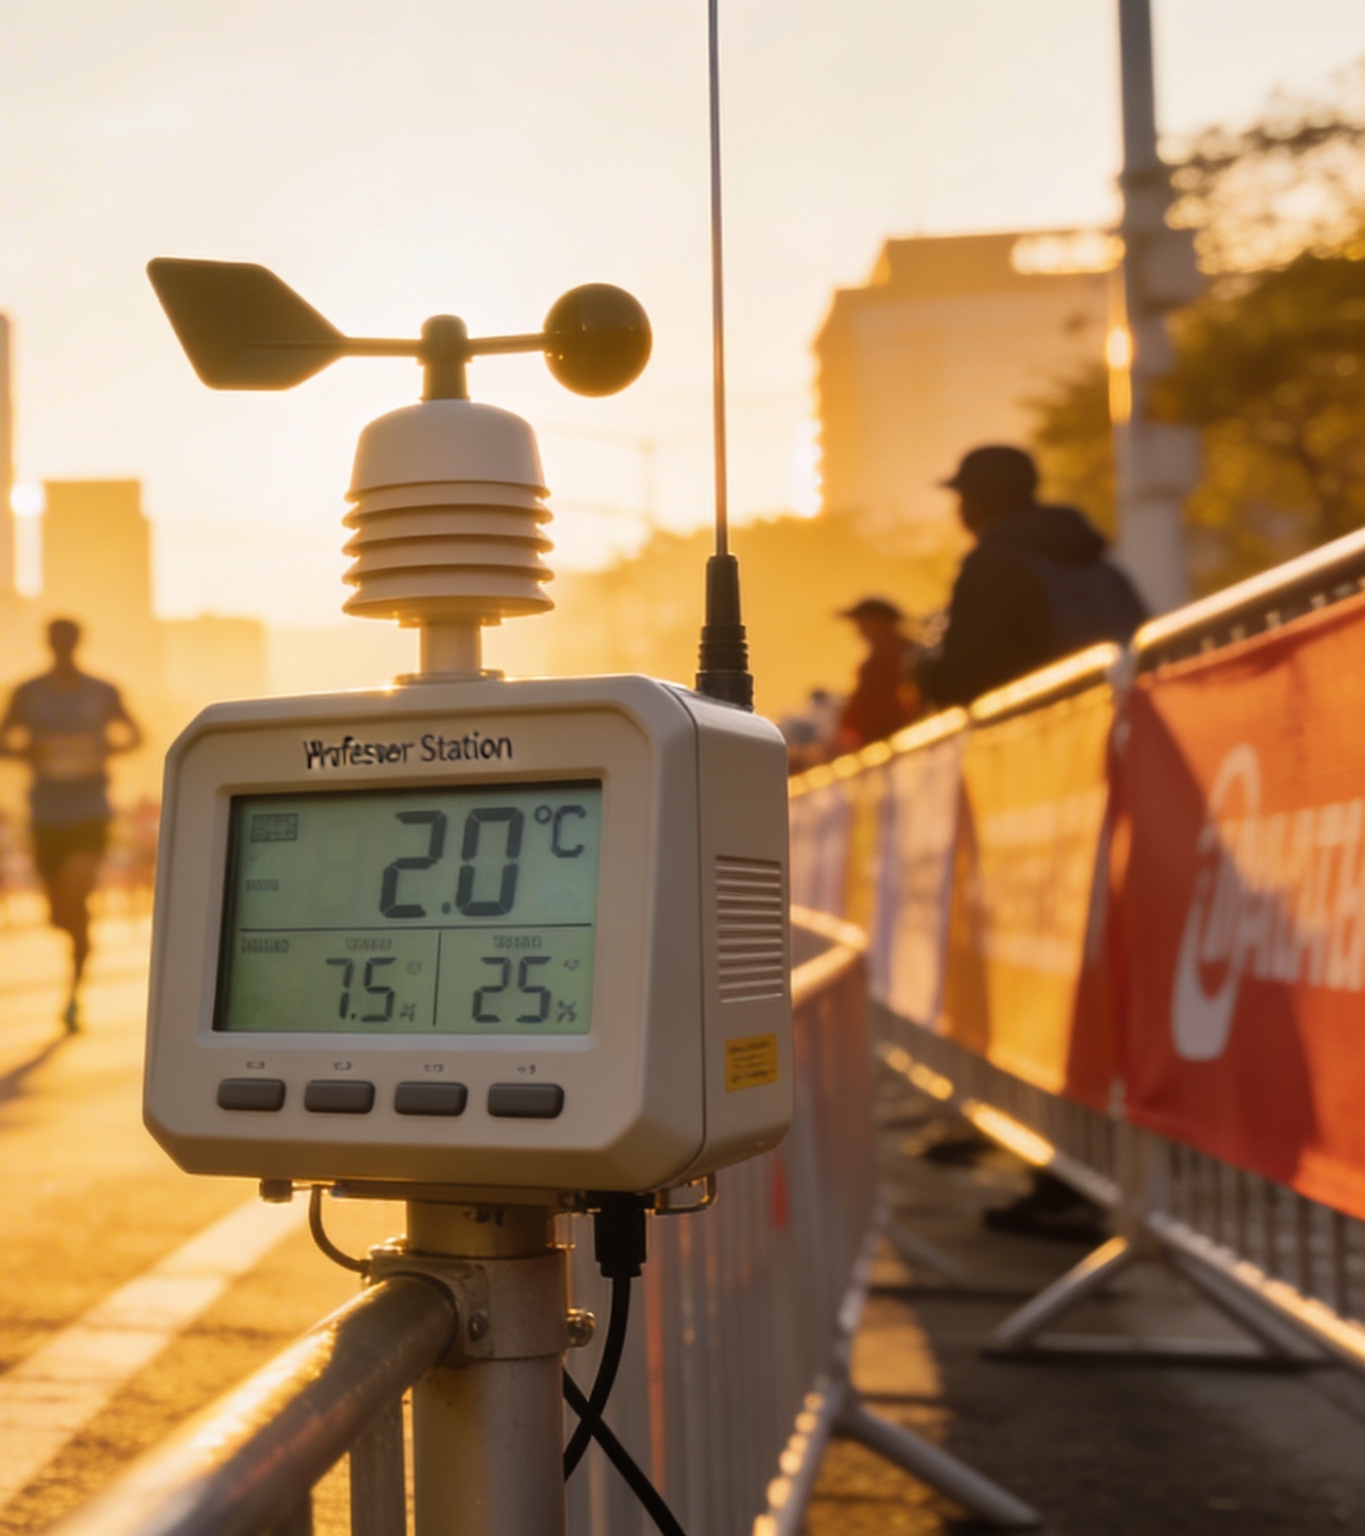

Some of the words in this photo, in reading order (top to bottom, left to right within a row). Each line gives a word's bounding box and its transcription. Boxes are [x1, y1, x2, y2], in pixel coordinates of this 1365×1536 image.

[420, 731, 512, 763] Station
[326, 957, 397, 1023] 7.5
[472, 956, 552, 1023] 25
